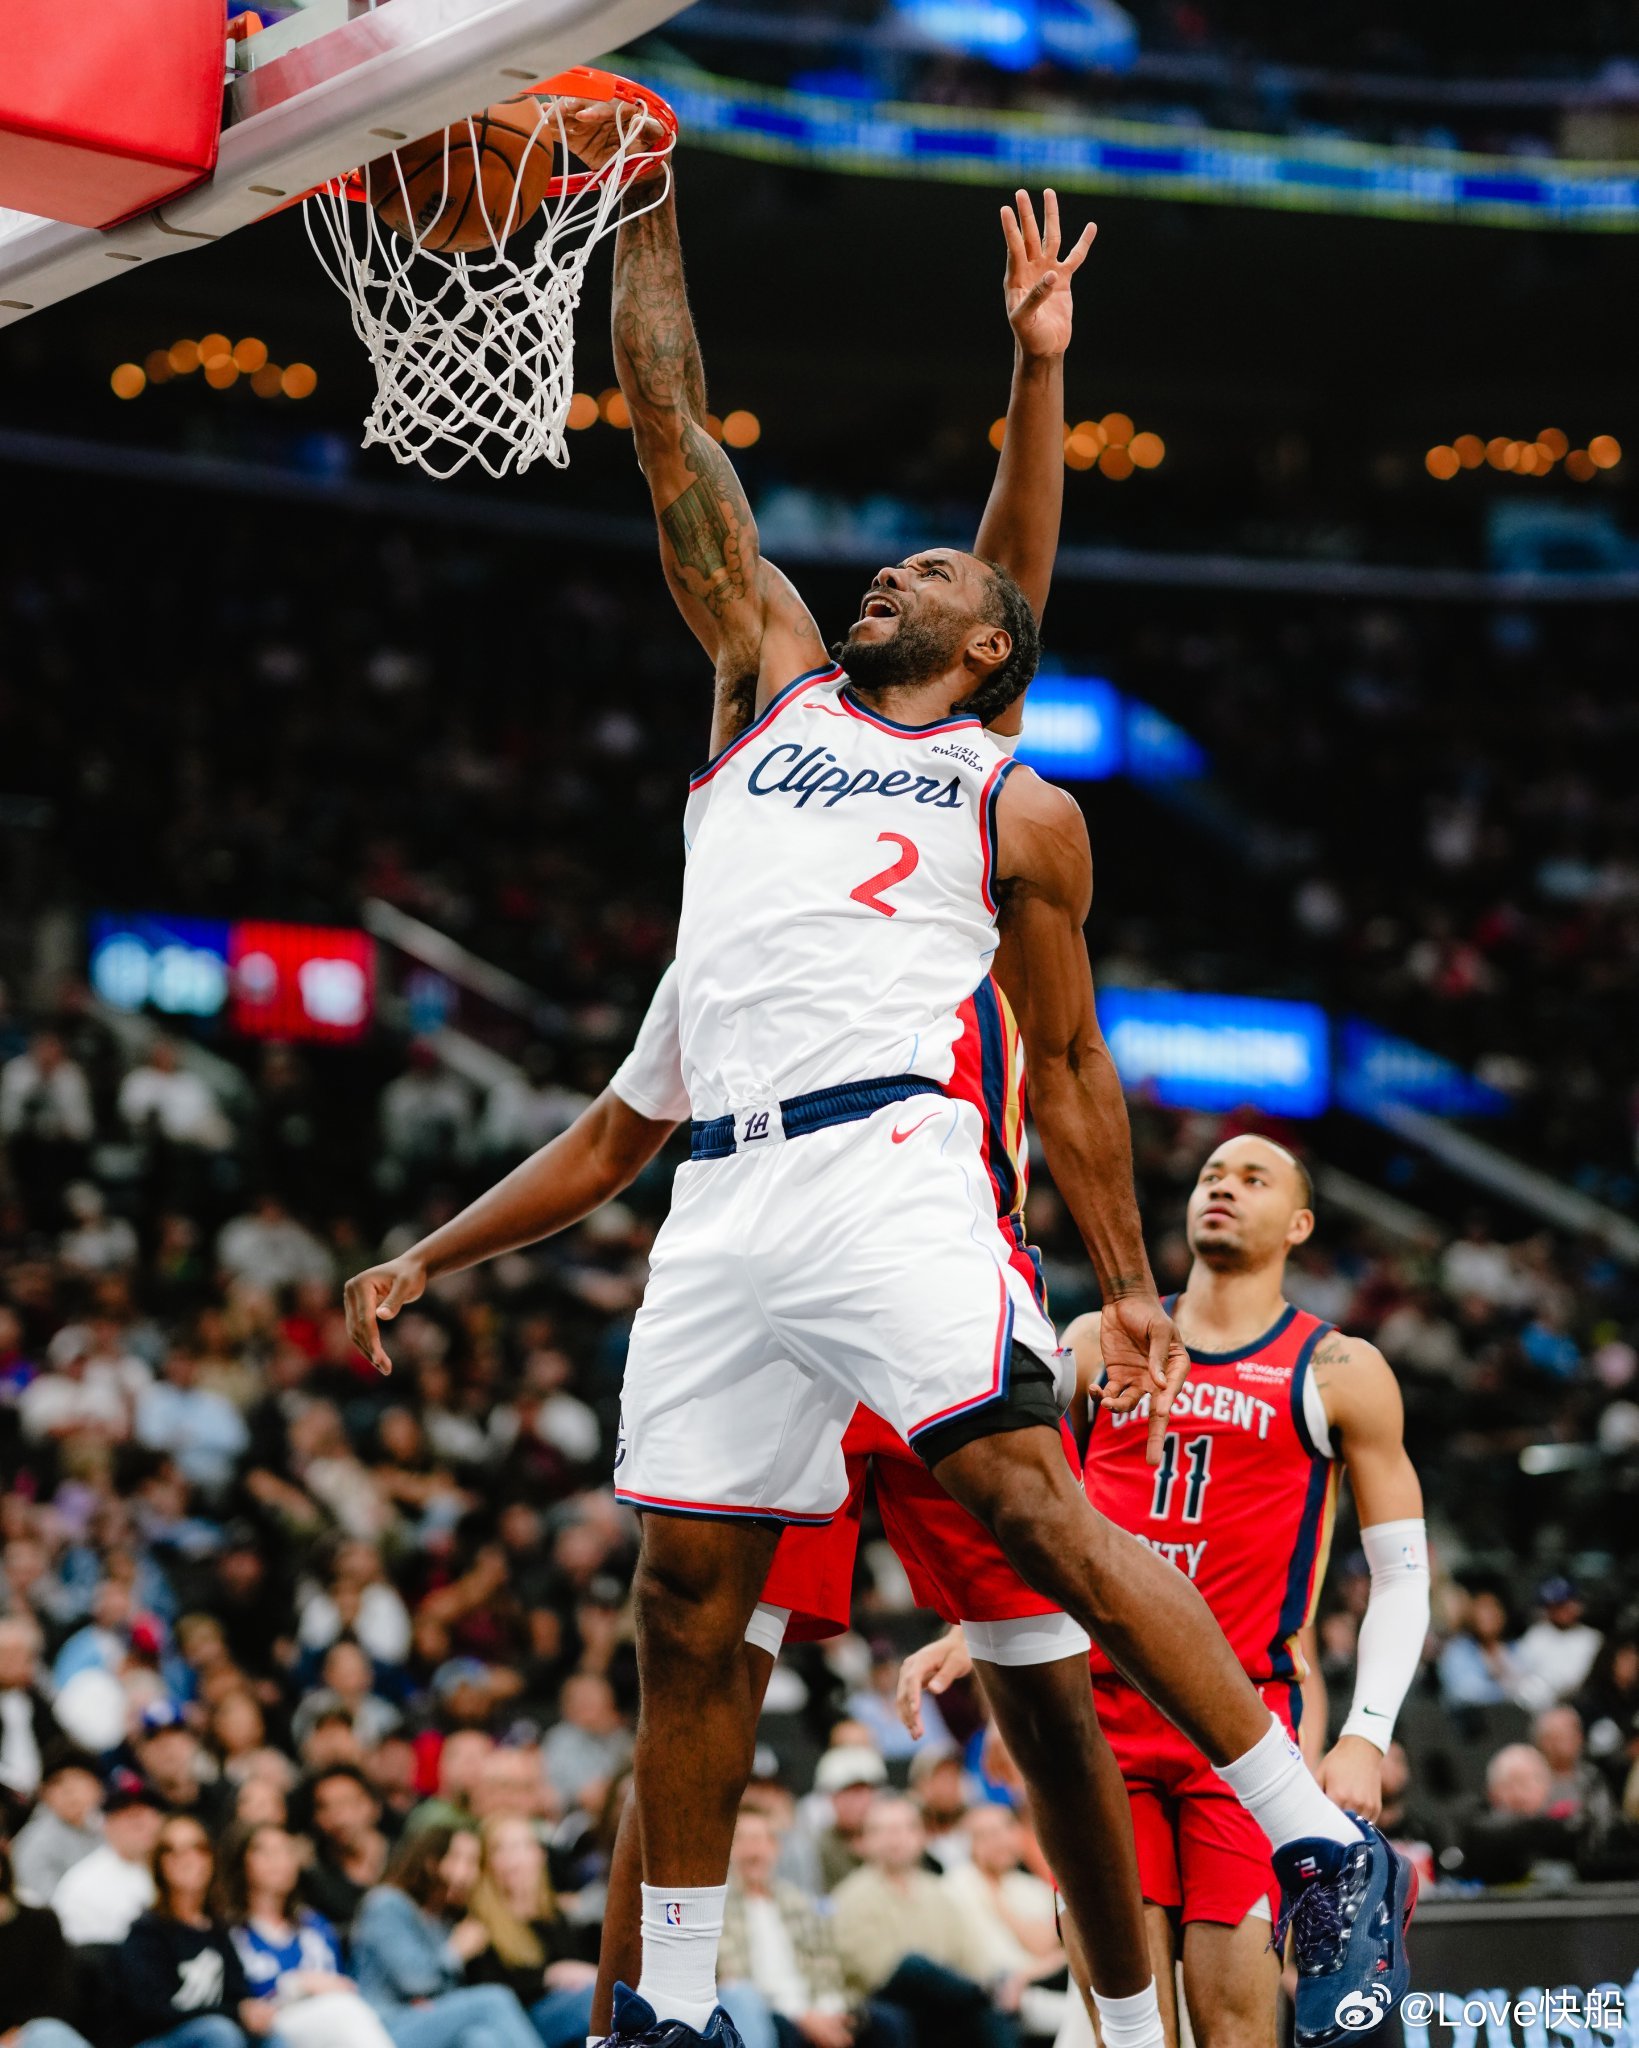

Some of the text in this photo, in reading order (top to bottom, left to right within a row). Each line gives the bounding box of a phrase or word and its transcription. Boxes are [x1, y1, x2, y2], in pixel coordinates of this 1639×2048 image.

[931, 746, 984, 772] RWANDA
[950, 743, 980, 760] VISIT
[747, 743, 964, 808] Clippers
[850, 832, 919, 917] 2
[1235, 1361, 1293, 1379] NEWAGE
[1149, 1432, 1214, 1524] 11
